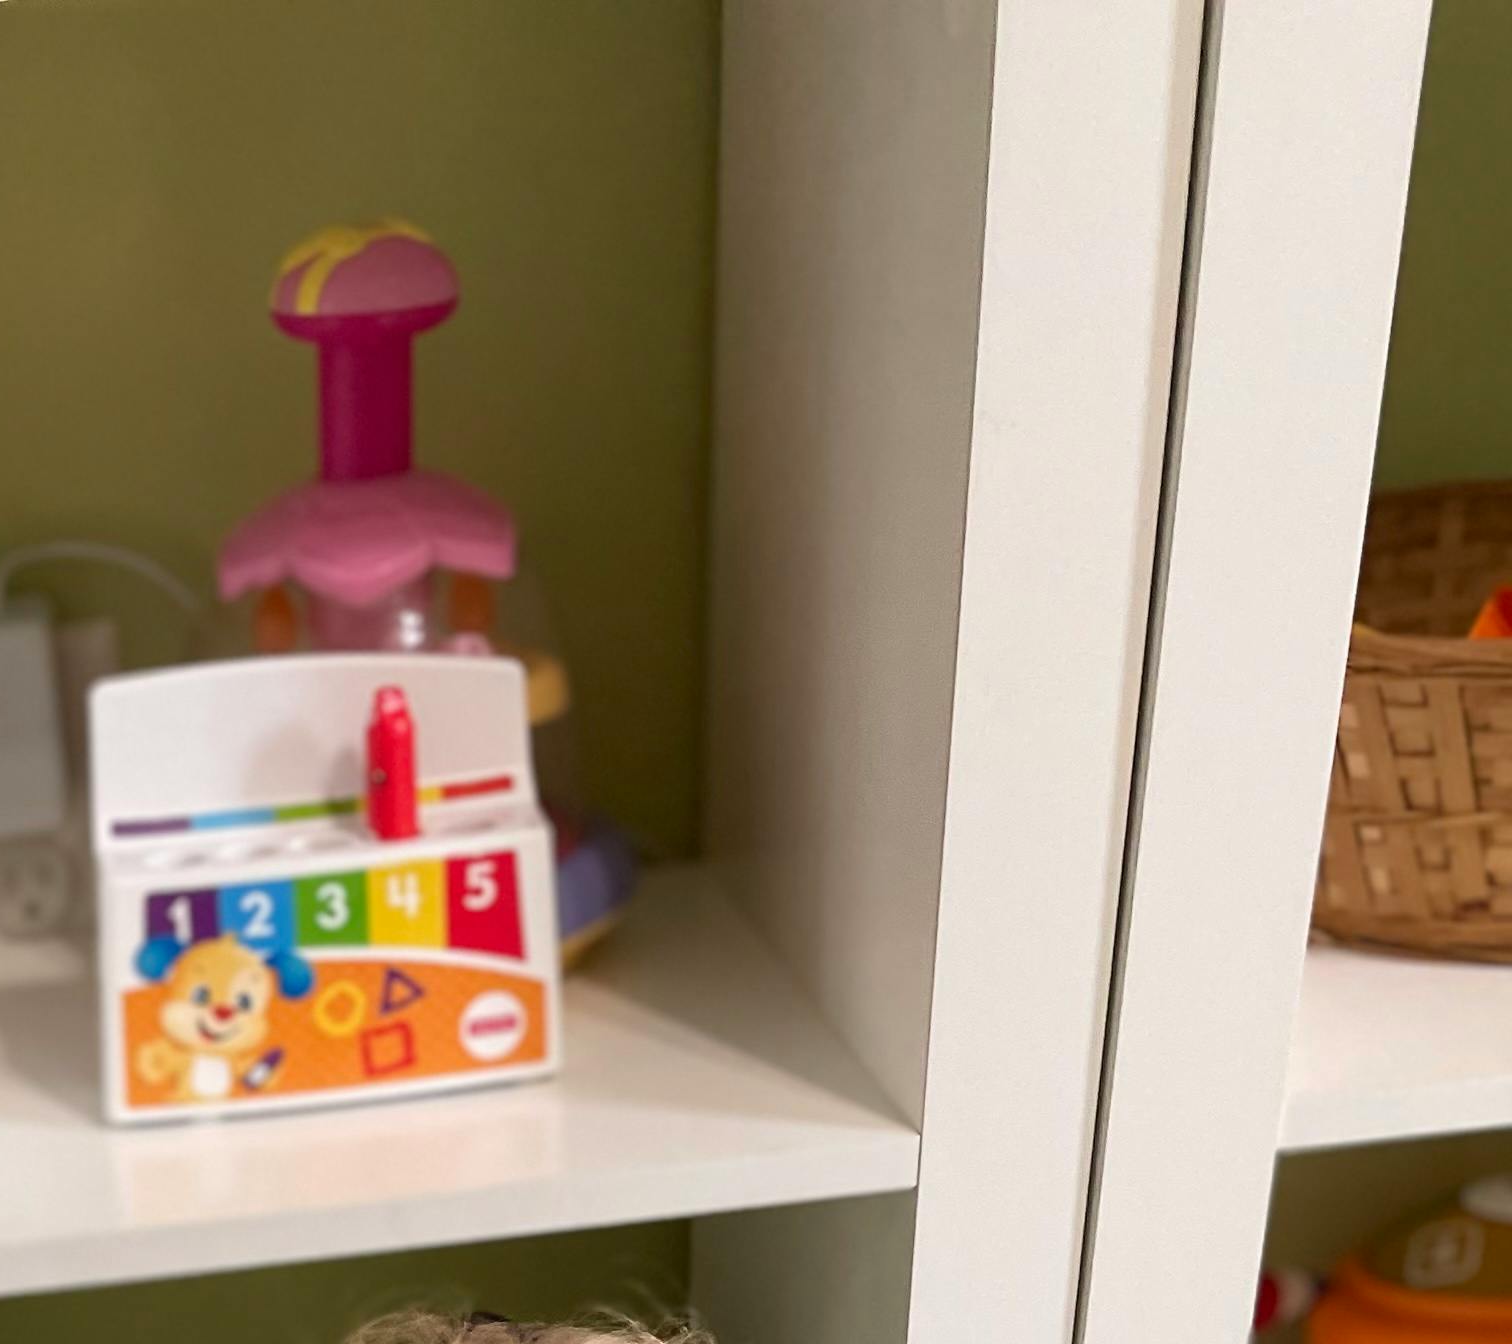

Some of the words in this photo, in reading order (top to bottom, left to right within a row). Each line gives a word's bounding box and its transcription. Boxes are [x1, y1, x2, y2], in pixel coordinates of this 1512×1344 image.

[167, 897, 193, 941] 1
[240, 892, 274, 935] 2
[315, 883, 350, 930] 3
[387, 872, 420, 917] 4
[462, 861, 495, 909] 5
